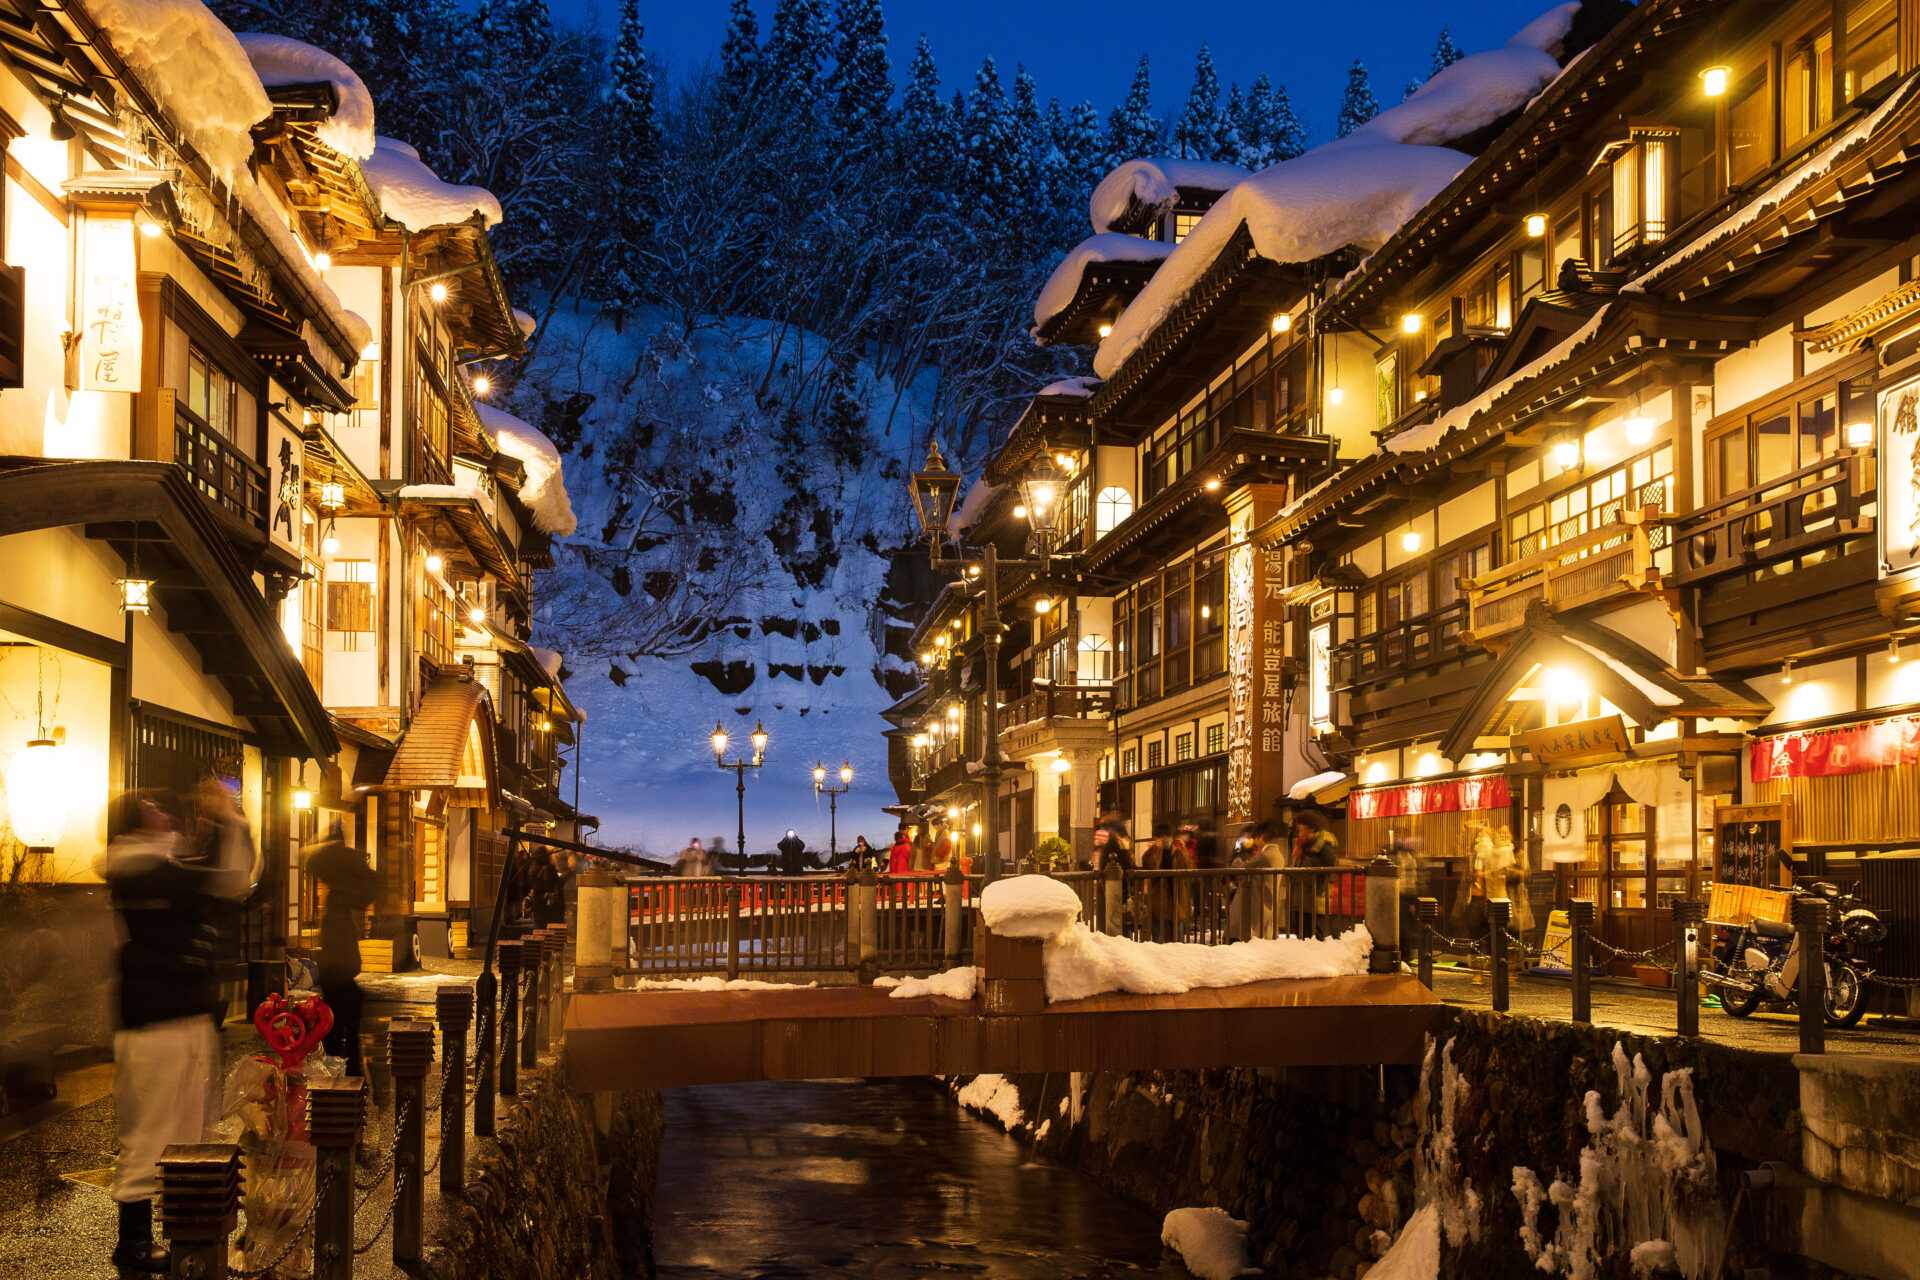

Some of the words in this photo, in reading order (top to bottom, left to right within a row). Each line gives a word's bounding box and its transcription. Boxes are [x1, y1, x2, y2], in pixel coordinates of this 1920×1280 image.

[1264, 550, 1282, 599] 湯元
[1262, 619, 1281, 752] 能登屋旅館
